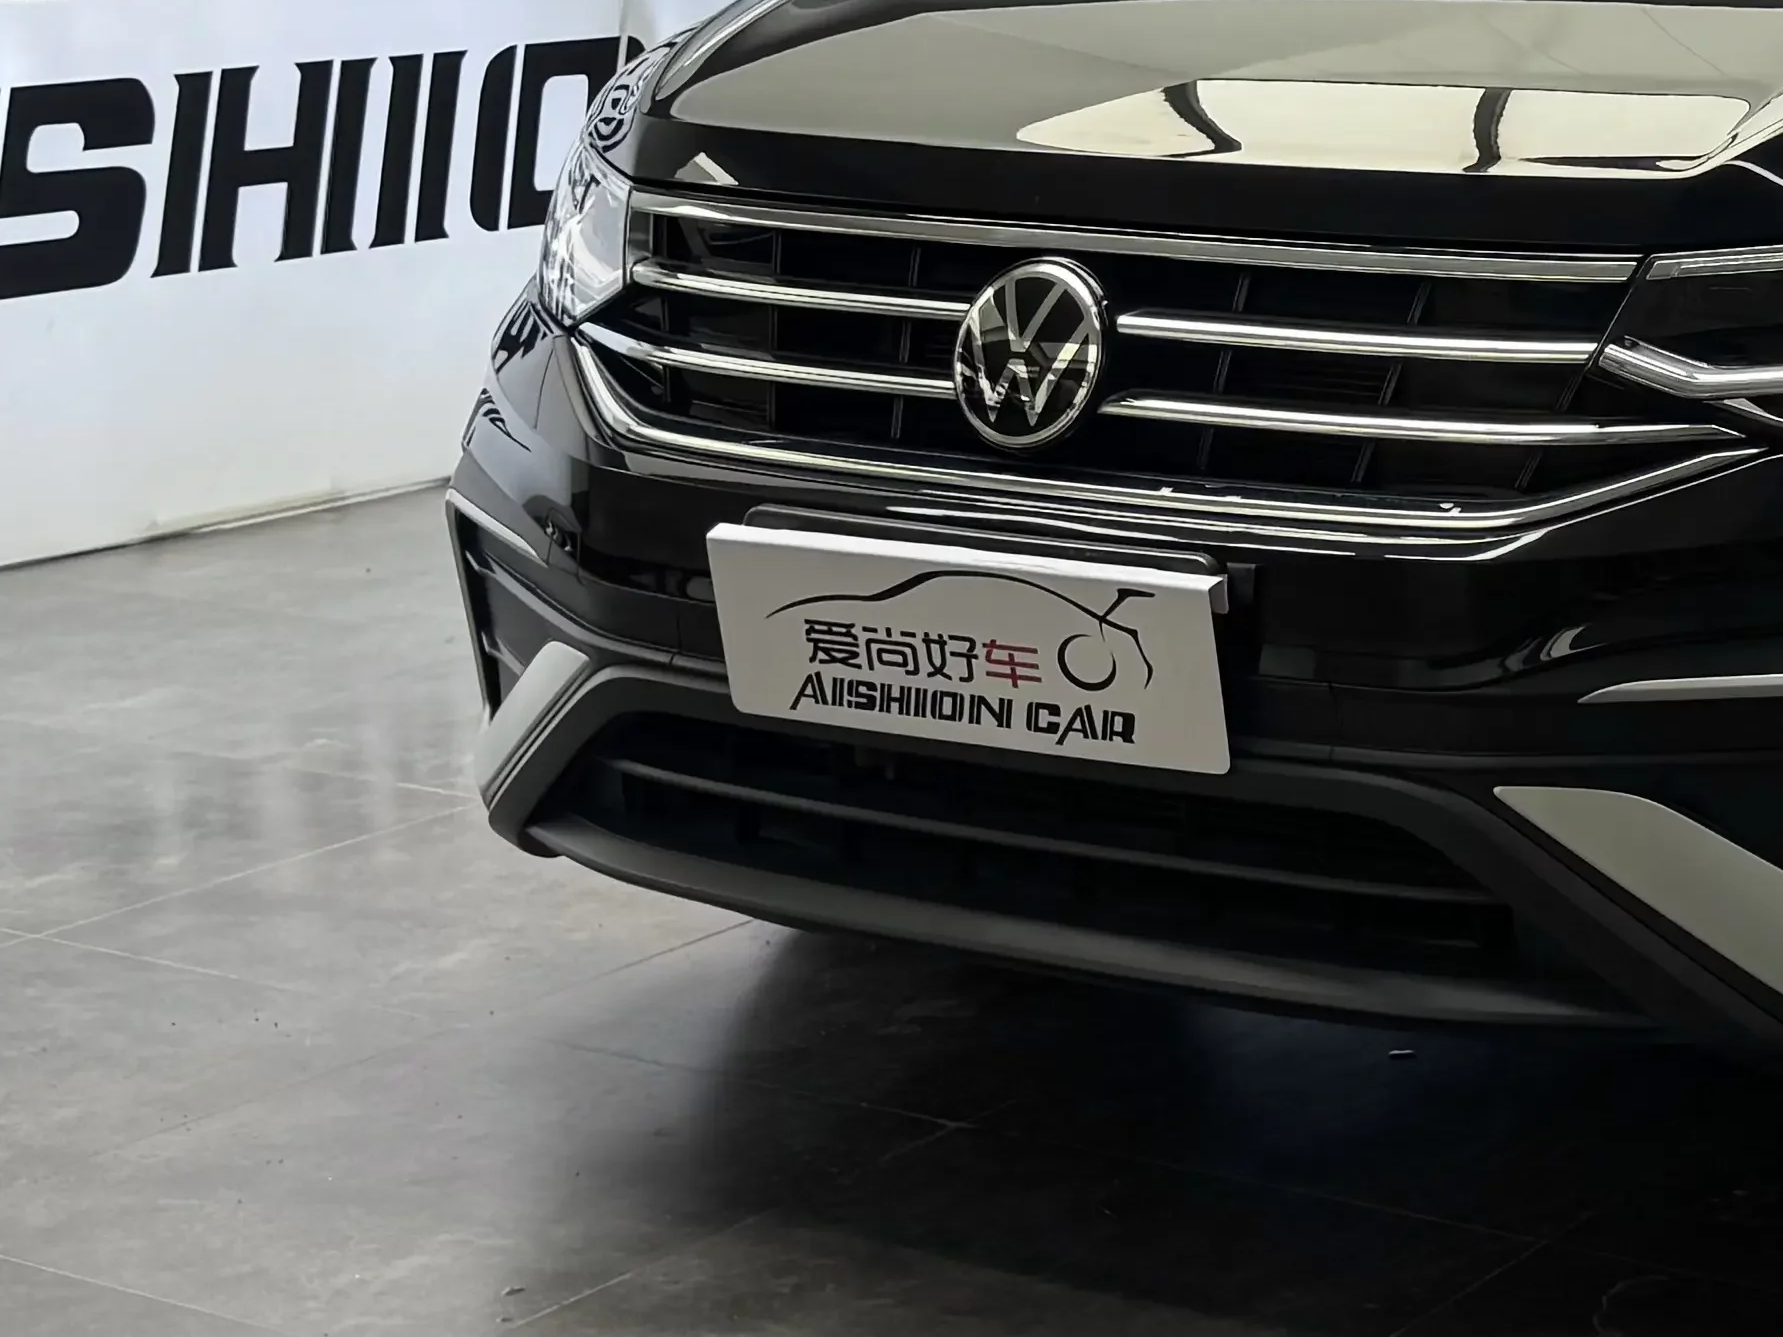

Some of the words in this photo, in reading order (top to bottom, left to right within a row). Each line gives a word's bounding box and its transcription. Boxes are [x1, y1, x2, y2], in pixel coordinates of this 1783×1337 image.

[803, 618, 1043, 689] 爱尚好车
[789, 671, 1016, 729] AISHION
[1025, 704, 1137, 746] CAR
